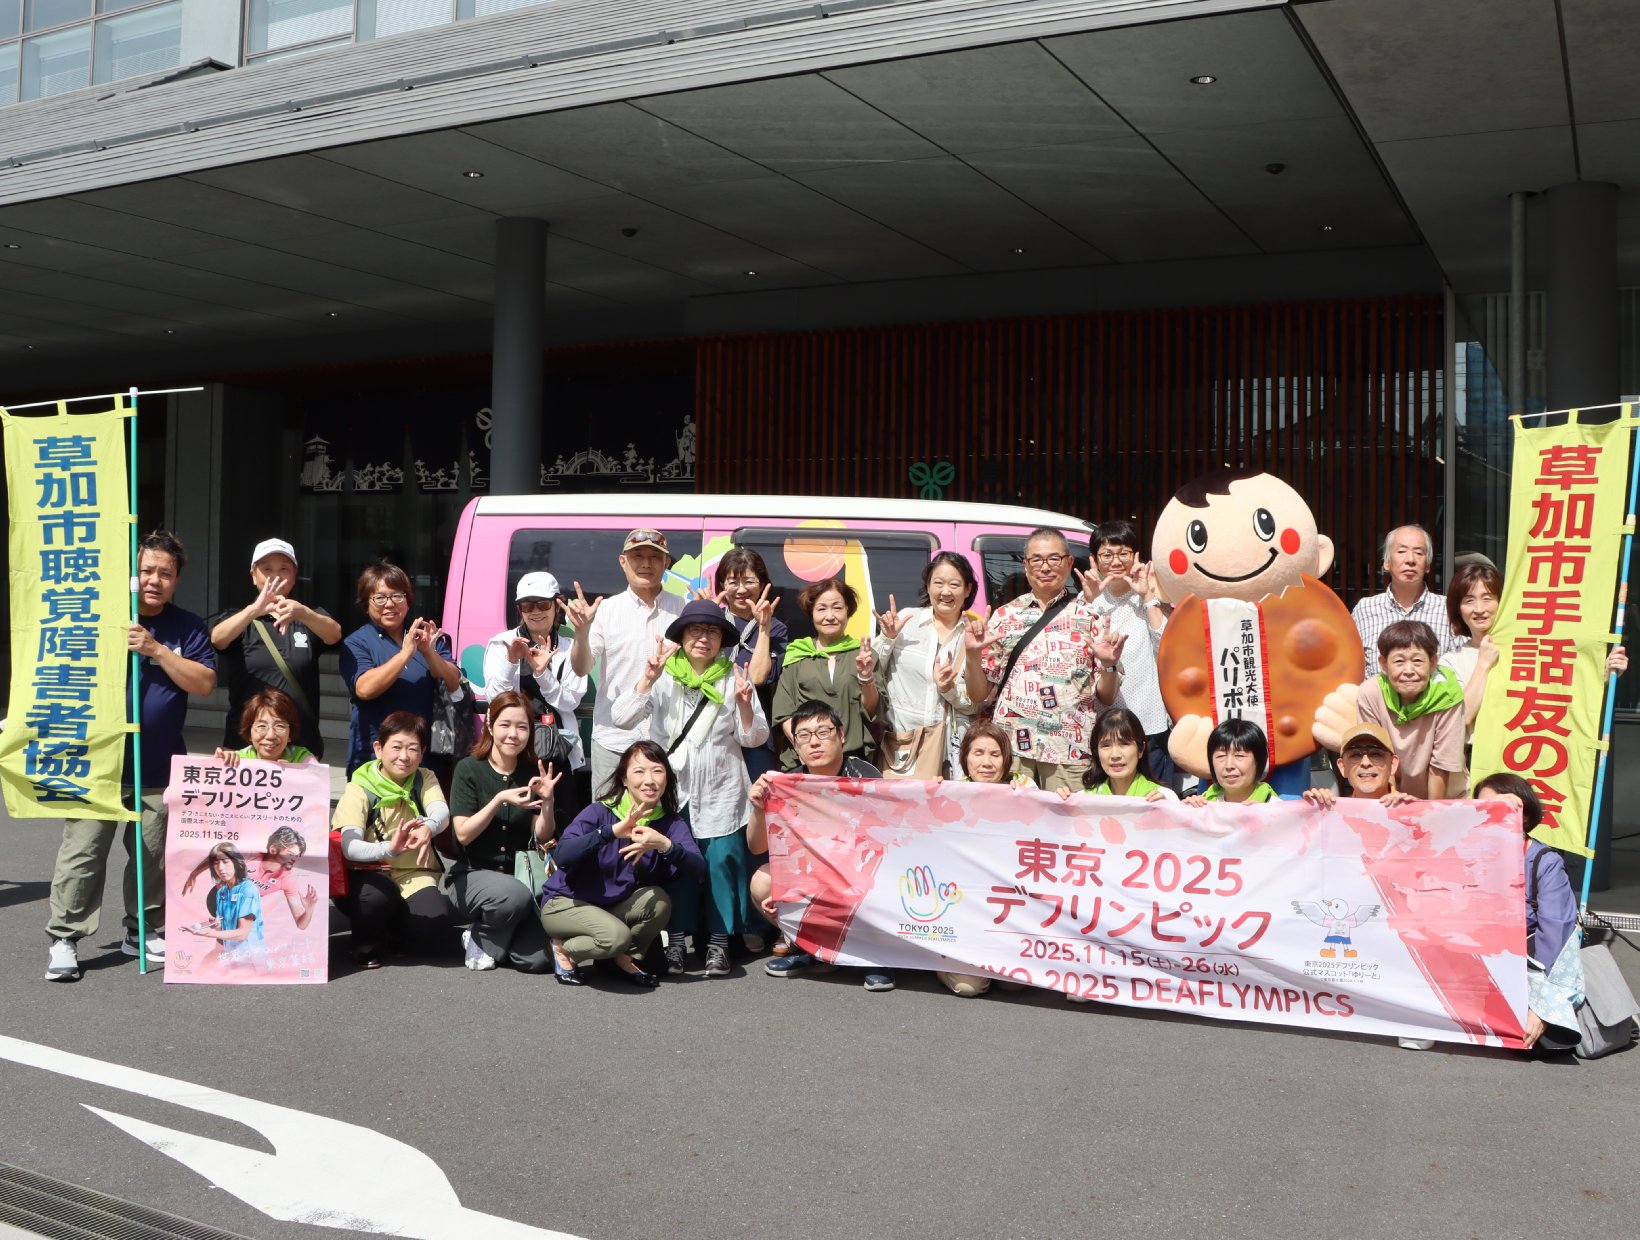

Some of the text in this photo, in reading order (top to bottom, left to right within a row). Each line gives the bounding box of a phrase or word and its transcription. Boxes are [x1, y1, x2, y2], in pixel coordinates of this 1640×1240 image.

[22, 435, 102, 804] 草加市聴覚障害者協会
[1240, 619, 1259, 707] 草加市観光大使
[181, 789, 304, 812] デフリンピック
[182, 765, 283, 788] 東京2025
[1015, 838, 1243, 897] 東京 2025
[899, 923, 955, 935] TOKYO 2025
[986, 885, 1272, 950] デフリンピック
[1045, 968, 1120, 1000] 2025
[1130, 977, 1355, 1018] DEAFLYMPICS
